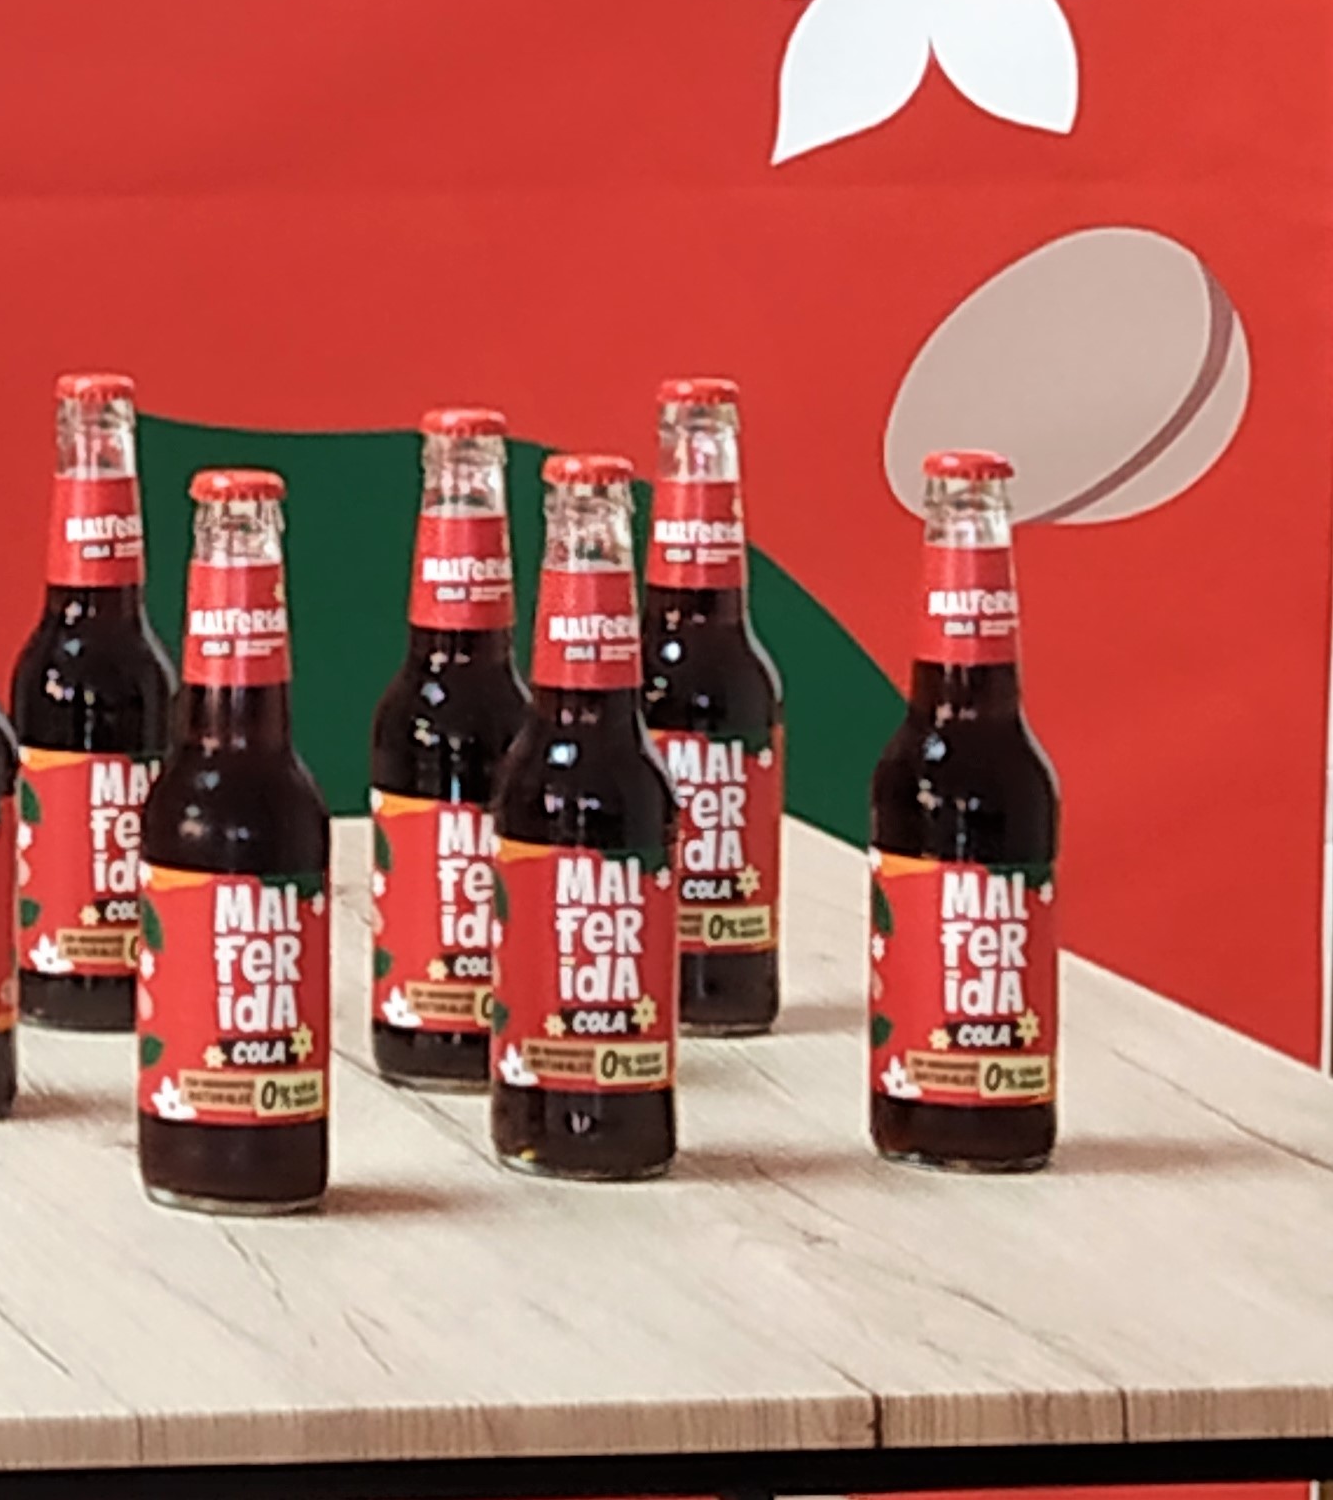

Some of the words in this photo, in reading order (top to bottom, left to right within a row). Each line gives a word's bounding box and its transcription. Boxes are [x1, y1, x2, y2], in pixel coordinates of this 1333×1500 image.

[668, 738, 747, 784] MAL
[90, 807, 141, 849] Fe
[437, 811, 496, 857] MA
[684, 829, 744, 871] dA
[93, 850, 140, 893] id
[437, 858, 494, 902] Fe
[556, 856, 645, 906] MAL
[682, 878, 732, 900] COLA
[104, 901, 140, 922] COL
[214, 883, 302, 933] MAL
[941, 871, 1029, 920] MAL
[441, 903, 489, 948] id
[555, 906, 644, 954] FeR
[940, 920, 1028, 968] FeR
[214, 935, 302, 984] FeR
[454, 955, 492, 977] COL
[559, 954, 640, 1003] idA
[217, 984, 298, 1033] idA
[944, 969, 1024, 1016] idA
[572, 1009, 628, 1034] COLA
[956, 1024, 1011, 1047] COLA
[232, 1040, 286, 1064] COLA
